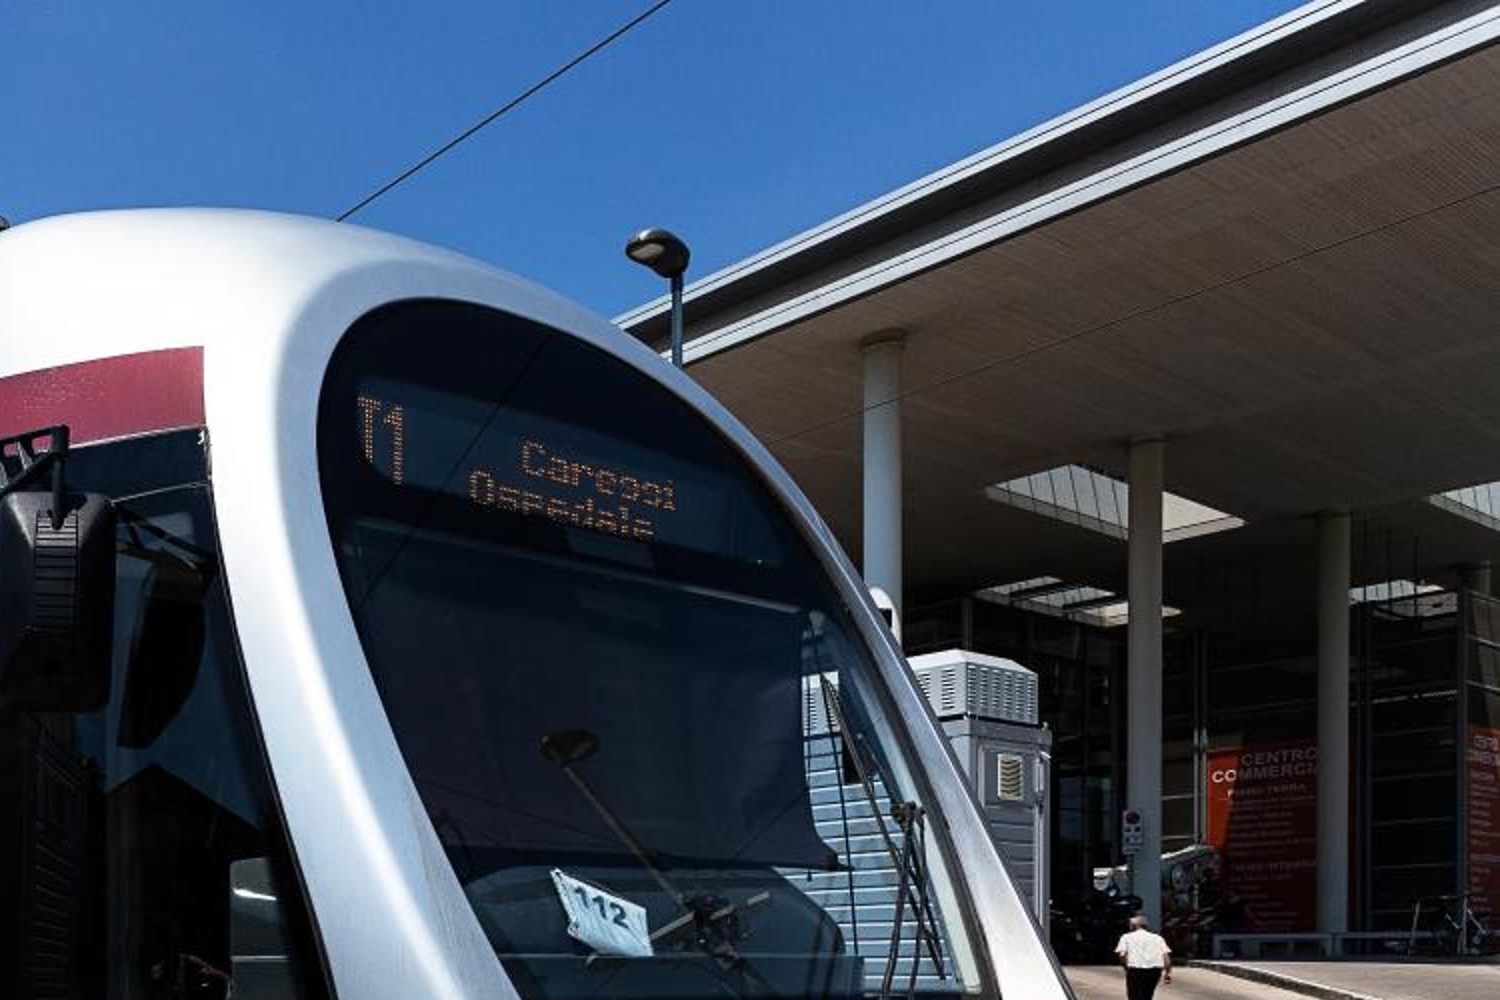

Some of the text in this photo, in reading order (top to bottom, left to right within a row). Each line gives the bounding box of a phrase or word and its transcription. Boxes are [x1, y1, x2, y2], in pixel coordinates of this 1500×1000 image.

[357, 394, 404, 487] T1
[520, 439, 676, 512] Careggi
[468, 469, 655, 540] Ospedale
[1241, 747, 1316, 767] CENTRO
[574, 886, 629, 930] 112
